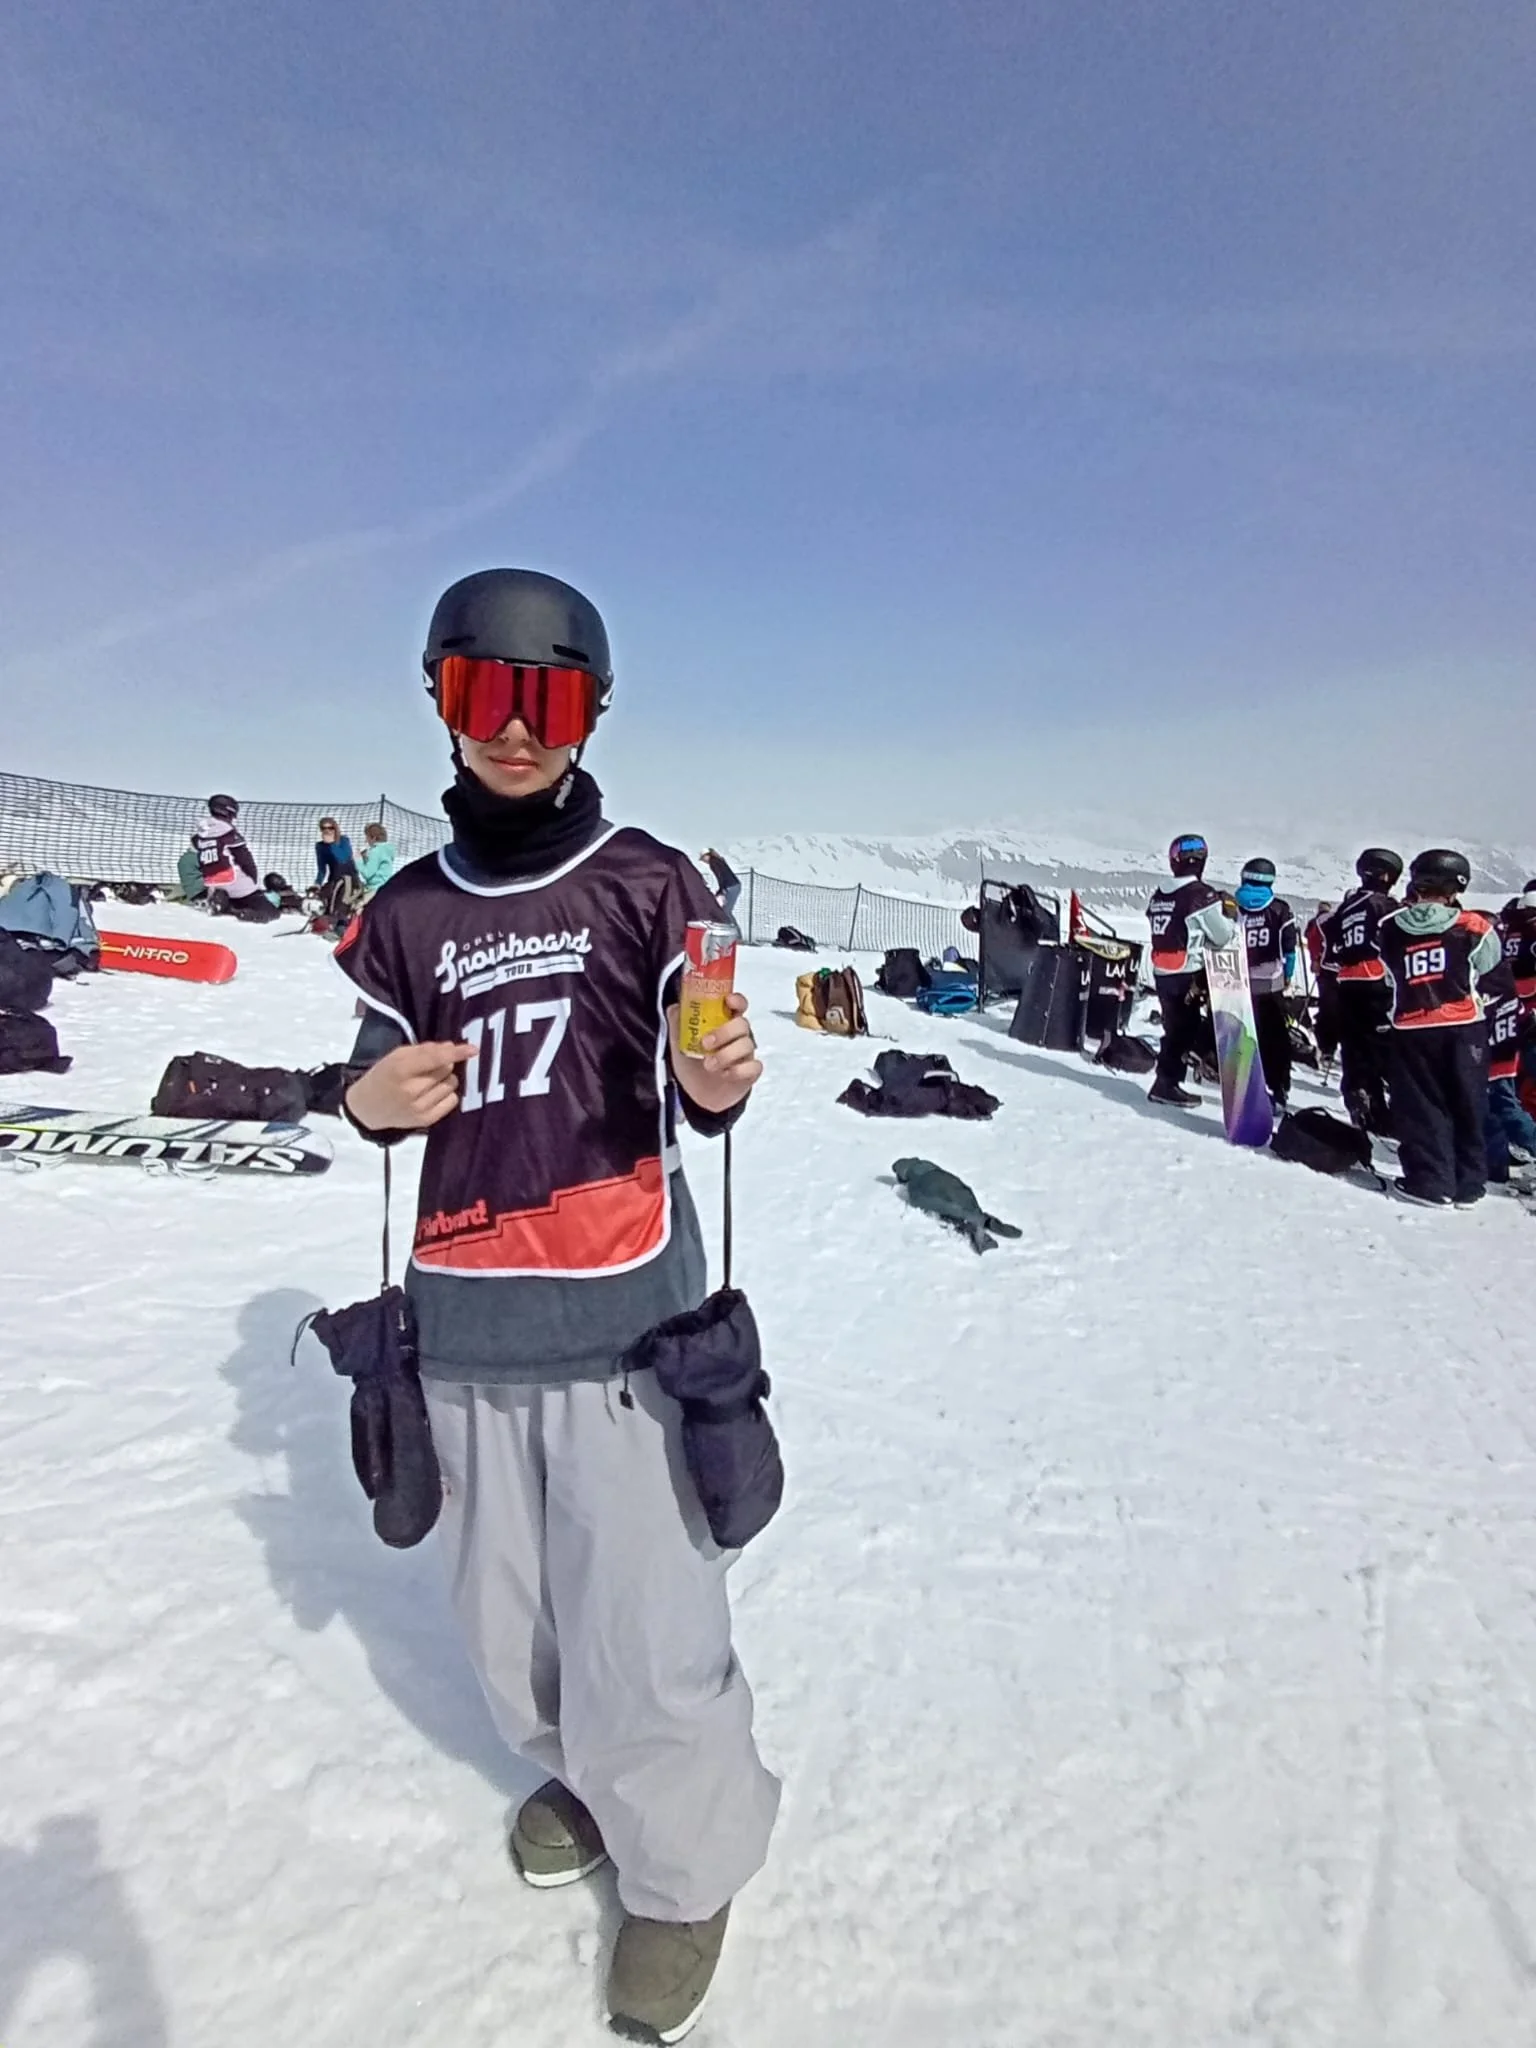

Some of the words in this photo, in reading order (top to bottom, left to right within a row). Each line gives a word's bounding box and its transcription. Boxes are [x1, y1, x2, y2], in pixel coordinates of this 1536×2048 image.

[123, 945, 189, 964] NITRO
[435, 928, 592, 993] Snowboard
[504, 962, 533, 978] TOUR
[1404, 947, 1446, 980] 169
[461, 997, 571, 1113] 117
